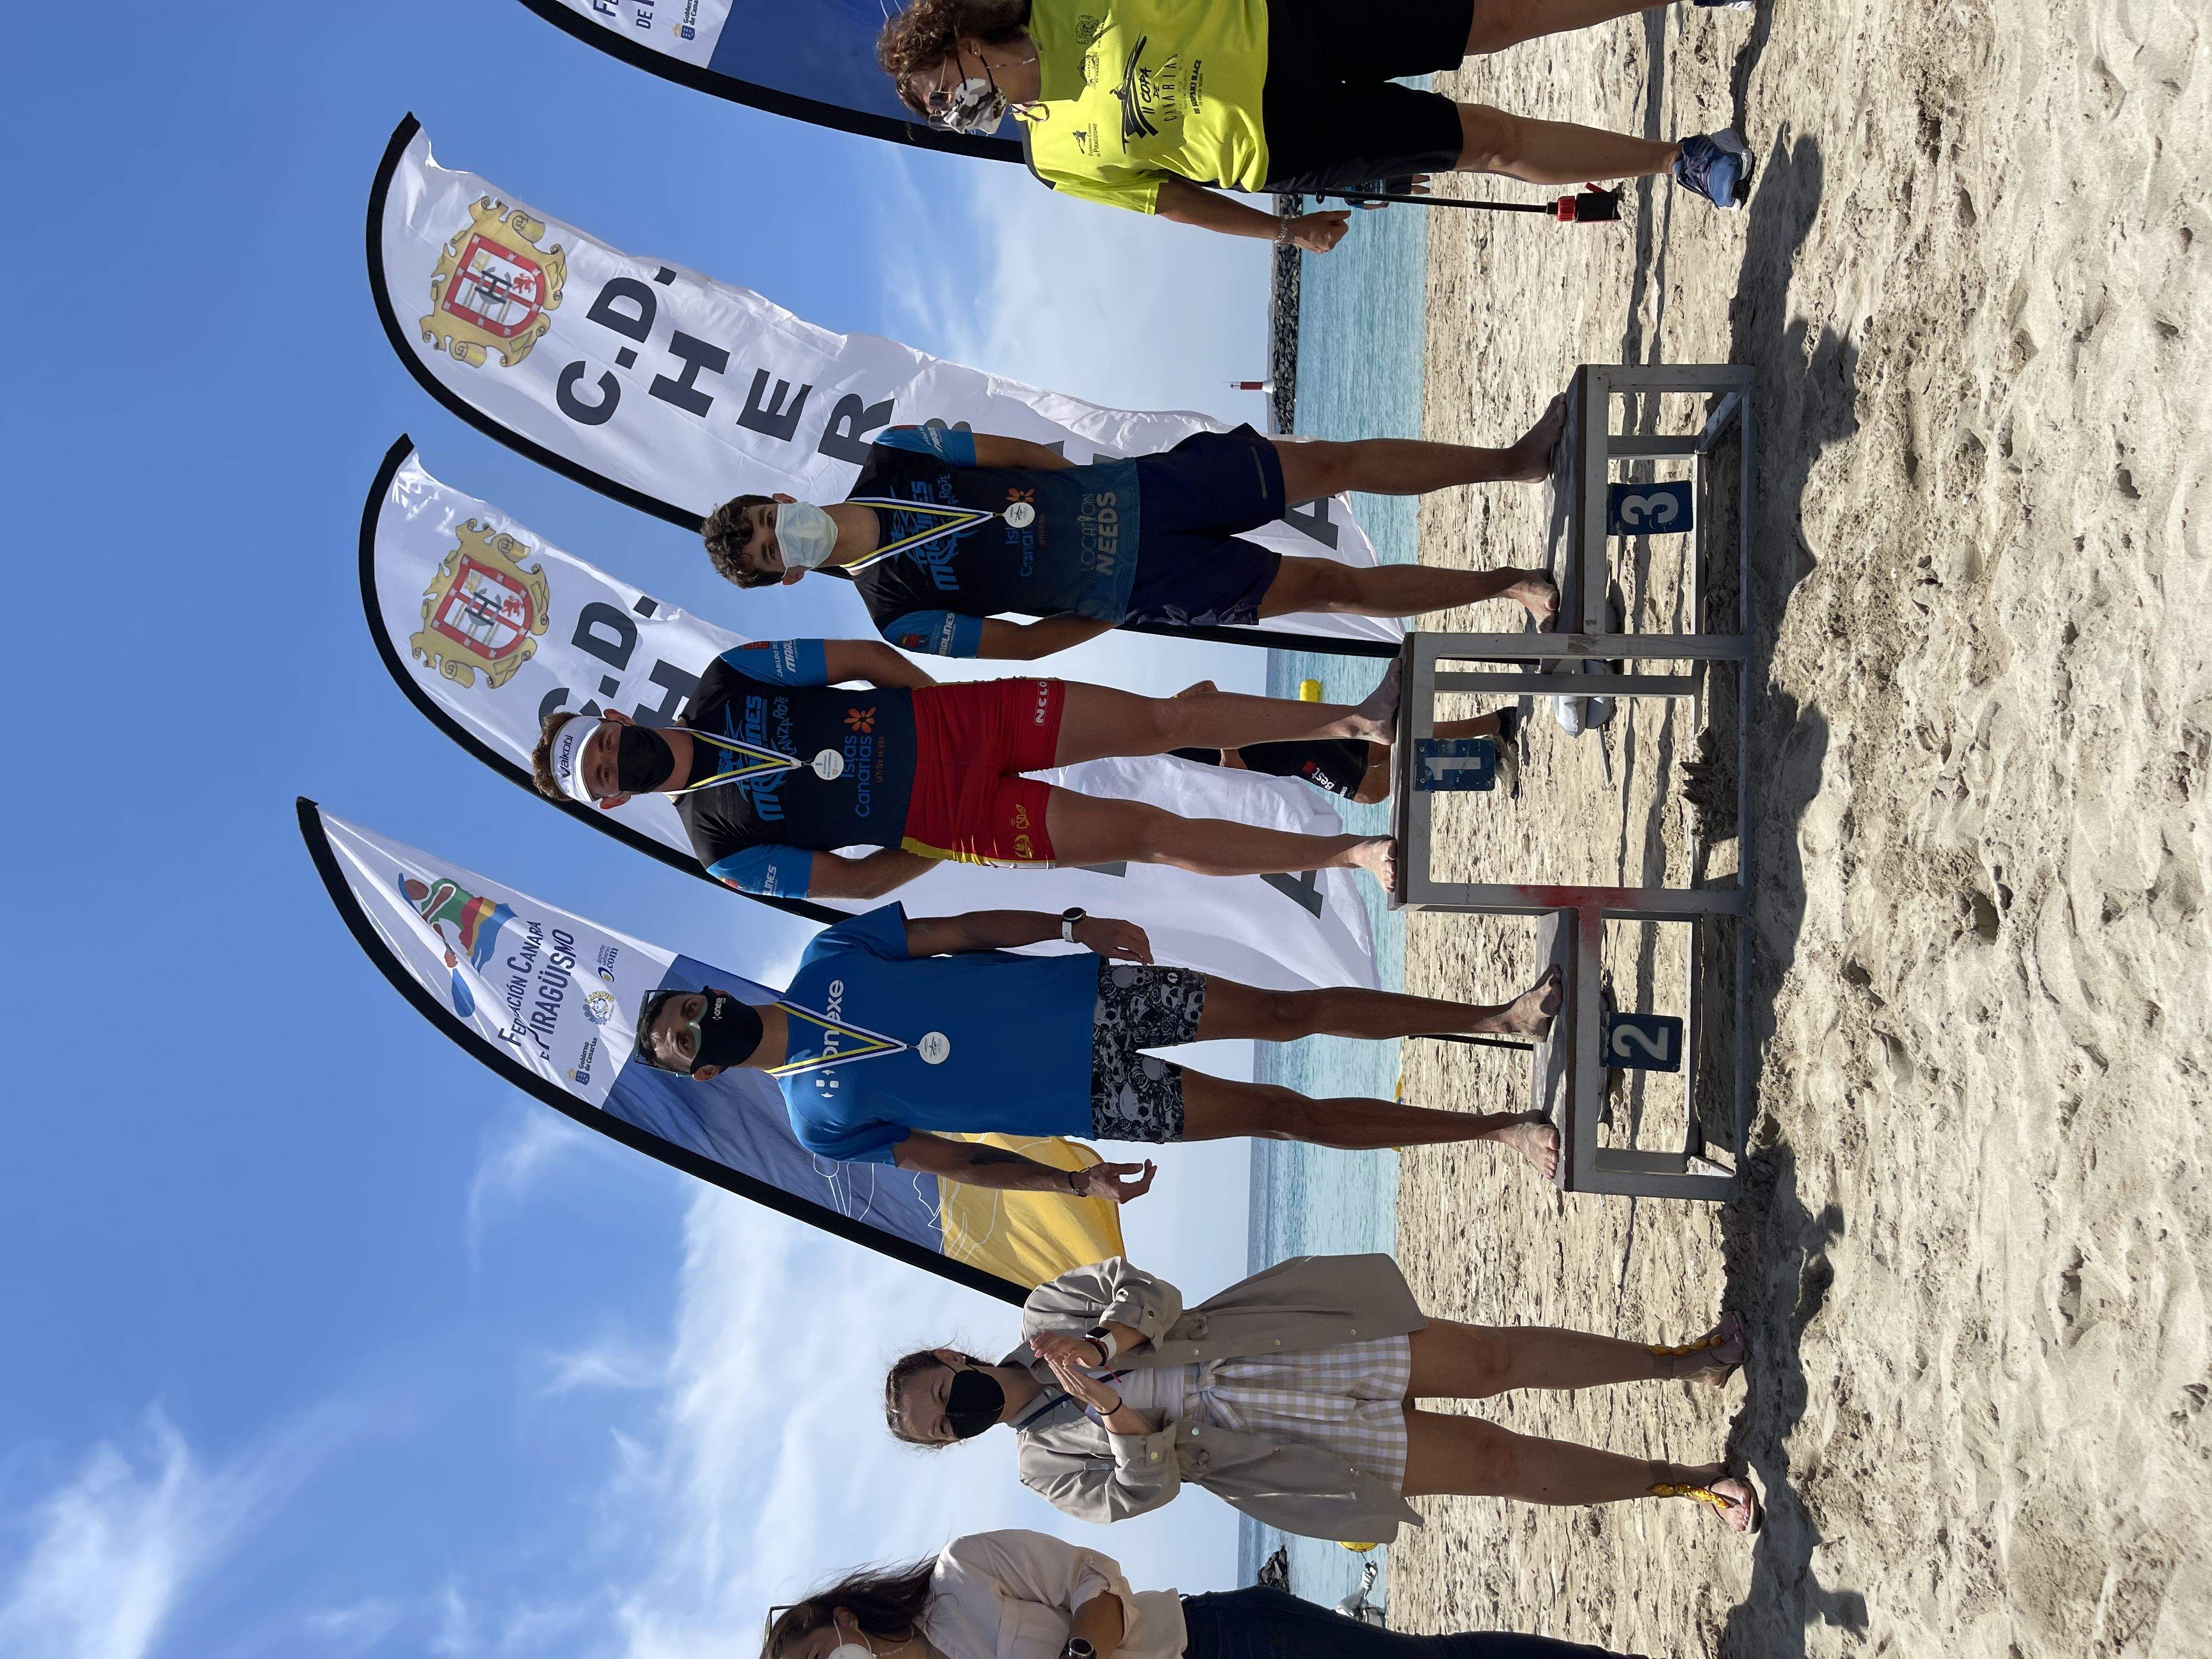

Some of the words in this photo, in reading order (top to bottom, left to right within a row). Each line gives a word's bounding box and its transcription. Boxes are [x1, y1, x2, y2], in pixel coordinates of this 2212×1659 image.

[636, 9, 653, 30] DE
[1138, 67, 1153, 103] COPA
[1190, 59, 1202, 81] RACE
[1153, 83, 1160, 99] DE
[1161, 53, 1179, 122] CANARIAS
[1141, 106, 1155, 114] II
[556, 266, 676, 426] C.D.
[1621, 492, 1679, 525] 3
[1096, 492, 1118, 576] NEEDS
[773, 650, 783, 677] CABILDO
[1035, 681, 1048, 724] NELO
[559, 735, 574, 778] Vaikobi
[840, 735, 857, 778] Islas
[1425, 757, 1481, 781] 1
[855, 735, 872, 817] Canarias
[1311, 766, 1335, 790] Best
[578, 1041, 590, 1069] Gobierno
[585, 1037, 598, 1064] Canarias
[1612, 1024, 1668, 1060] 2
[584, 1063, 591, 1071] de
